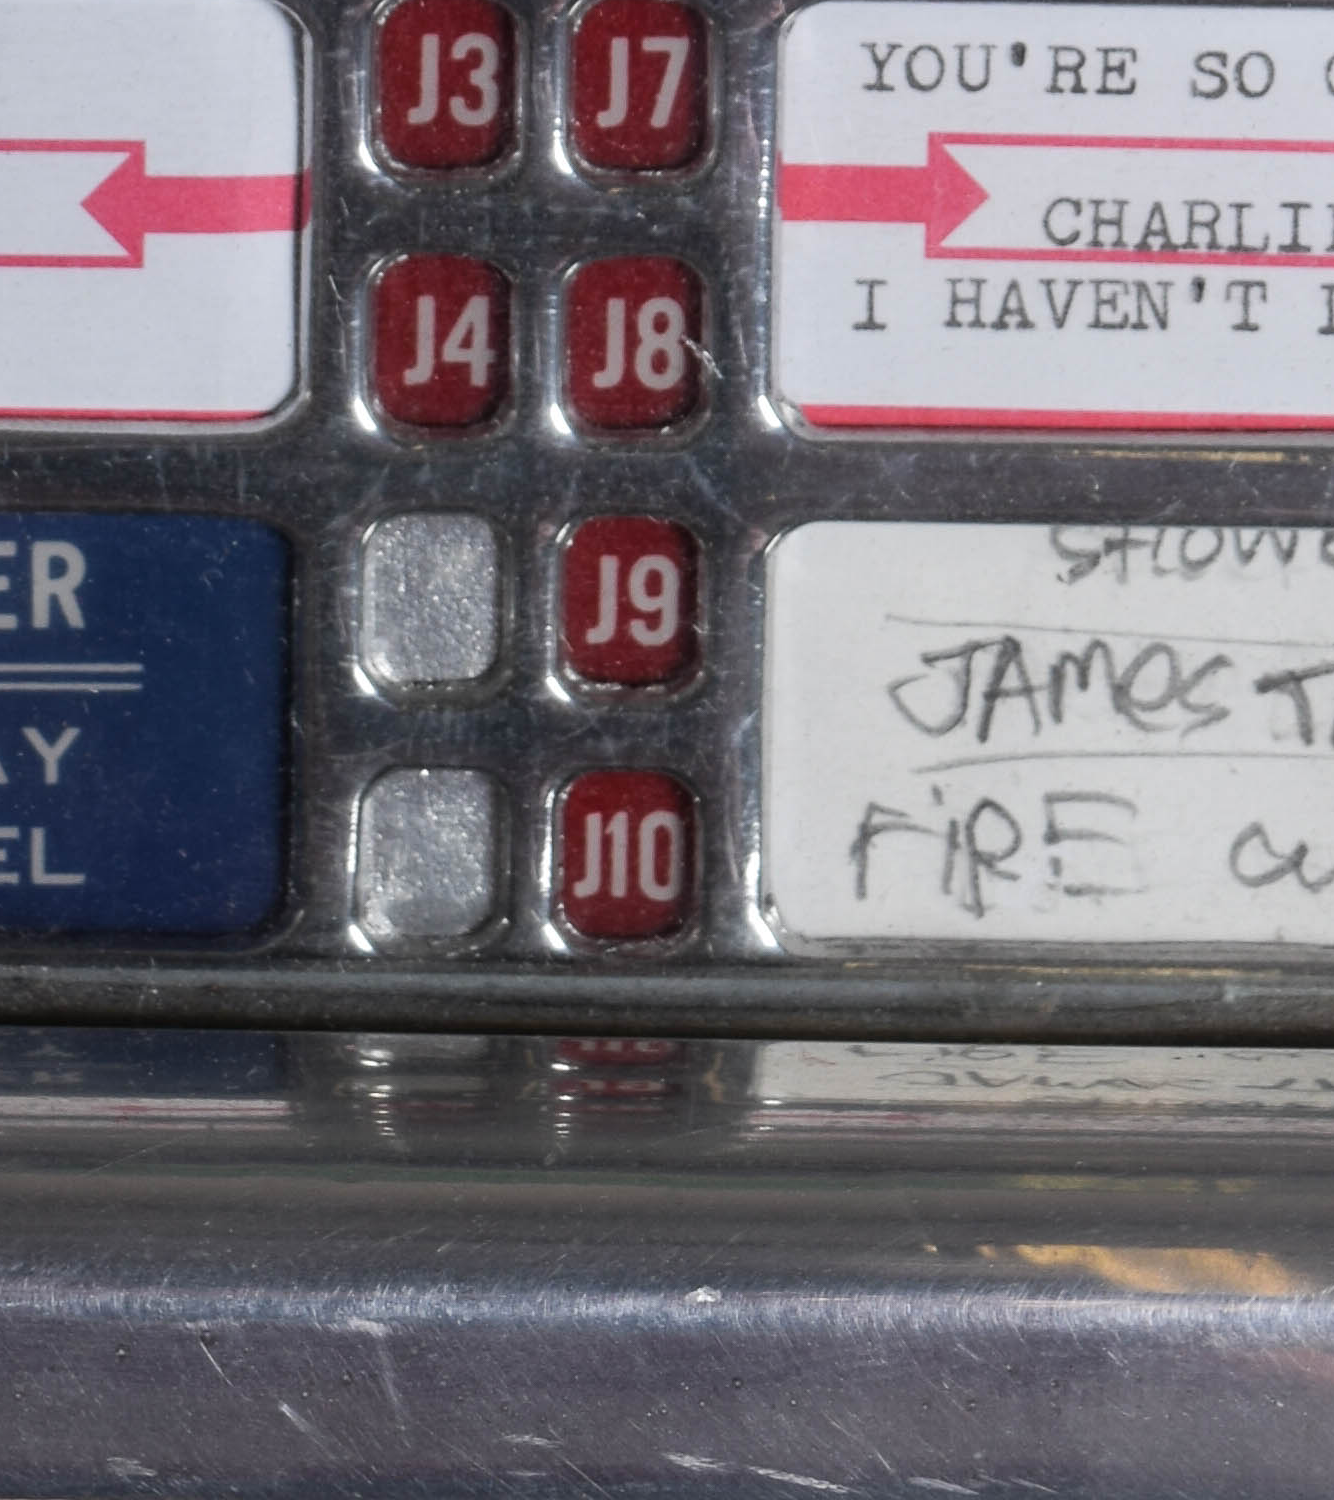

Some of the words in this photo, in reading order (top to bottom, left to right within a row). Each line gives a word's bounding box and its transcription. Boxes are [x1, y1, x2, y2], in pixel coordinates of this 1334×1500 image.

[407, 32, 499, 126] J3
[596, 36, 689, 130] J7
[861, 41, 1137, 96] YOU'RE
[1190, 51, 1275, 100] SO
[404, 294, 495, 388] J4
[593, 297, 685, 391] J8
[852, 279, 887, 332] I
[943, 275, 1268, 333] HAVEN'T
[586, 554, 678, 646] J9
[574, 811, 685, 901] J10
